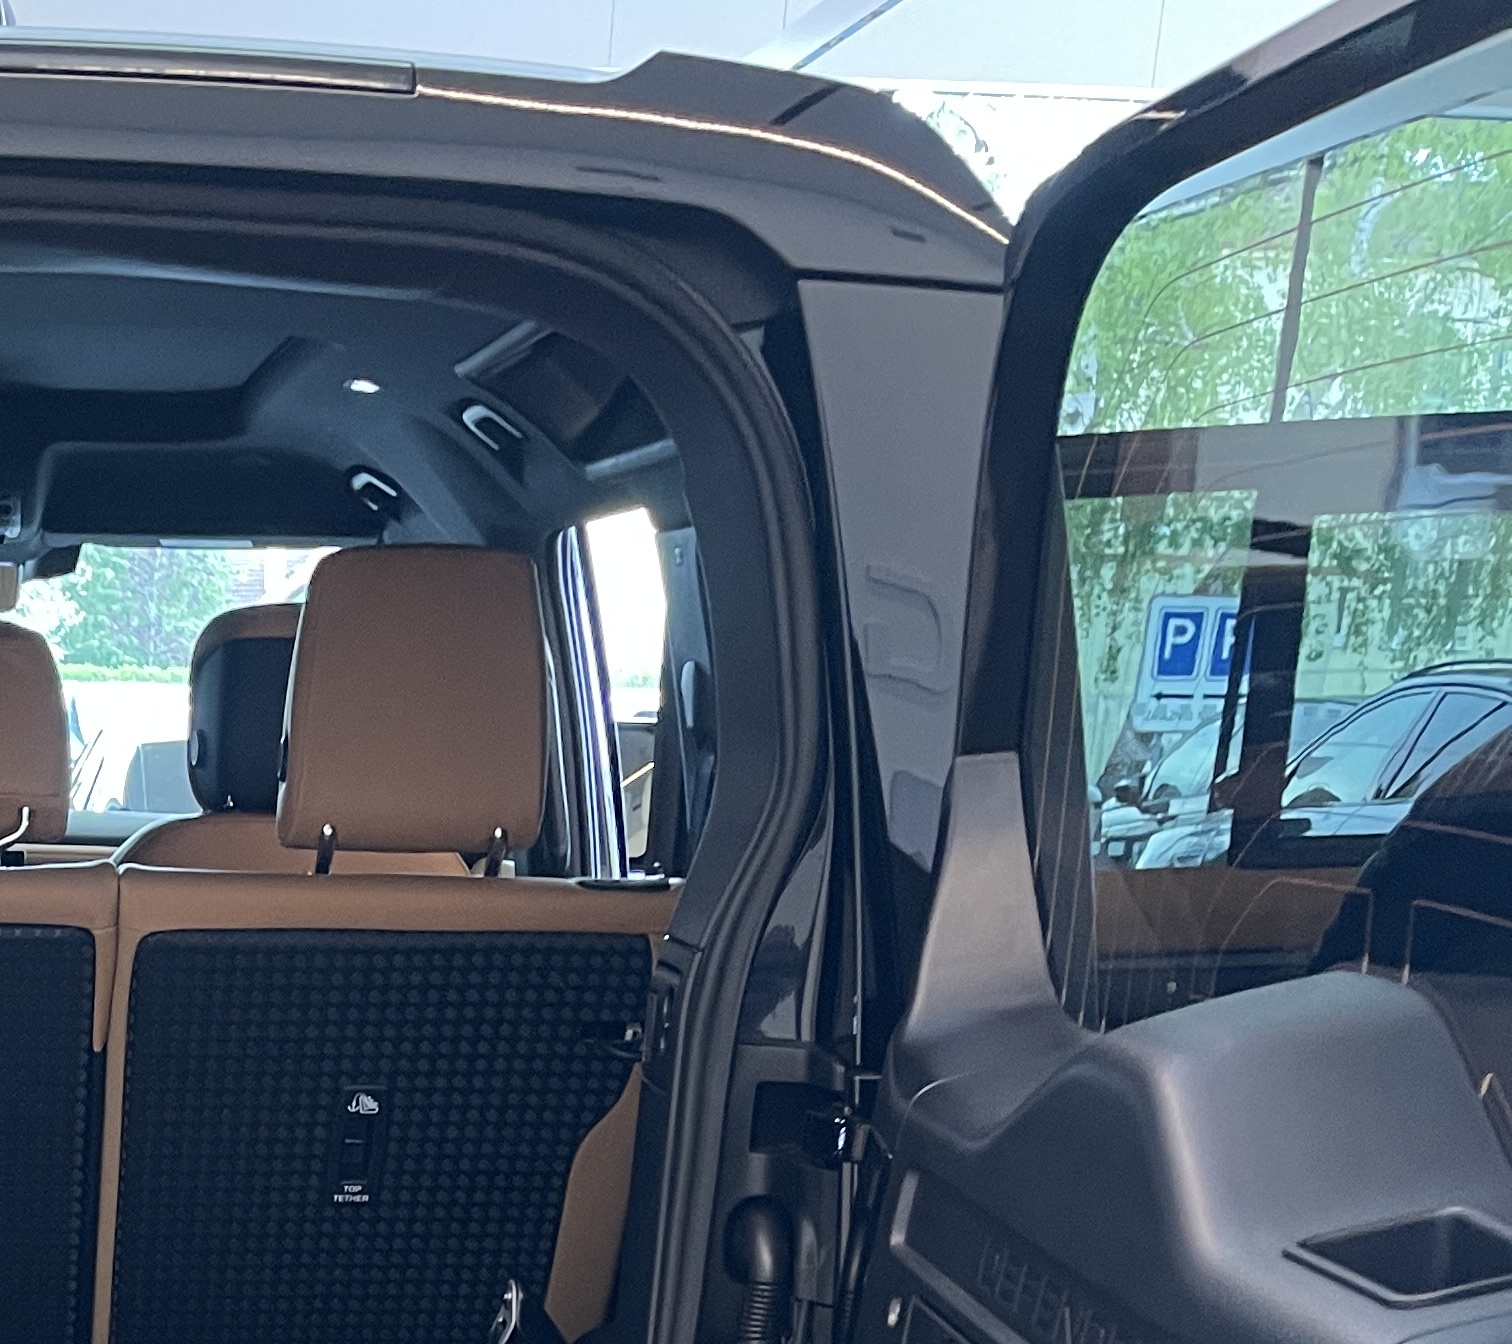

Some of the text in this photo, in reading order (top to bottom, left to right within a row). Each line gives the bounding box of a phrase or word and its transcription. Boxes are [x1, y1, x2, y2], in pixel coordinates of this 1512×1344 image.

[1163, 617, 1196, 660] P
[343, 1185, 363, 1193] TOP
[333, 1194, 369, 1203] TETHER
